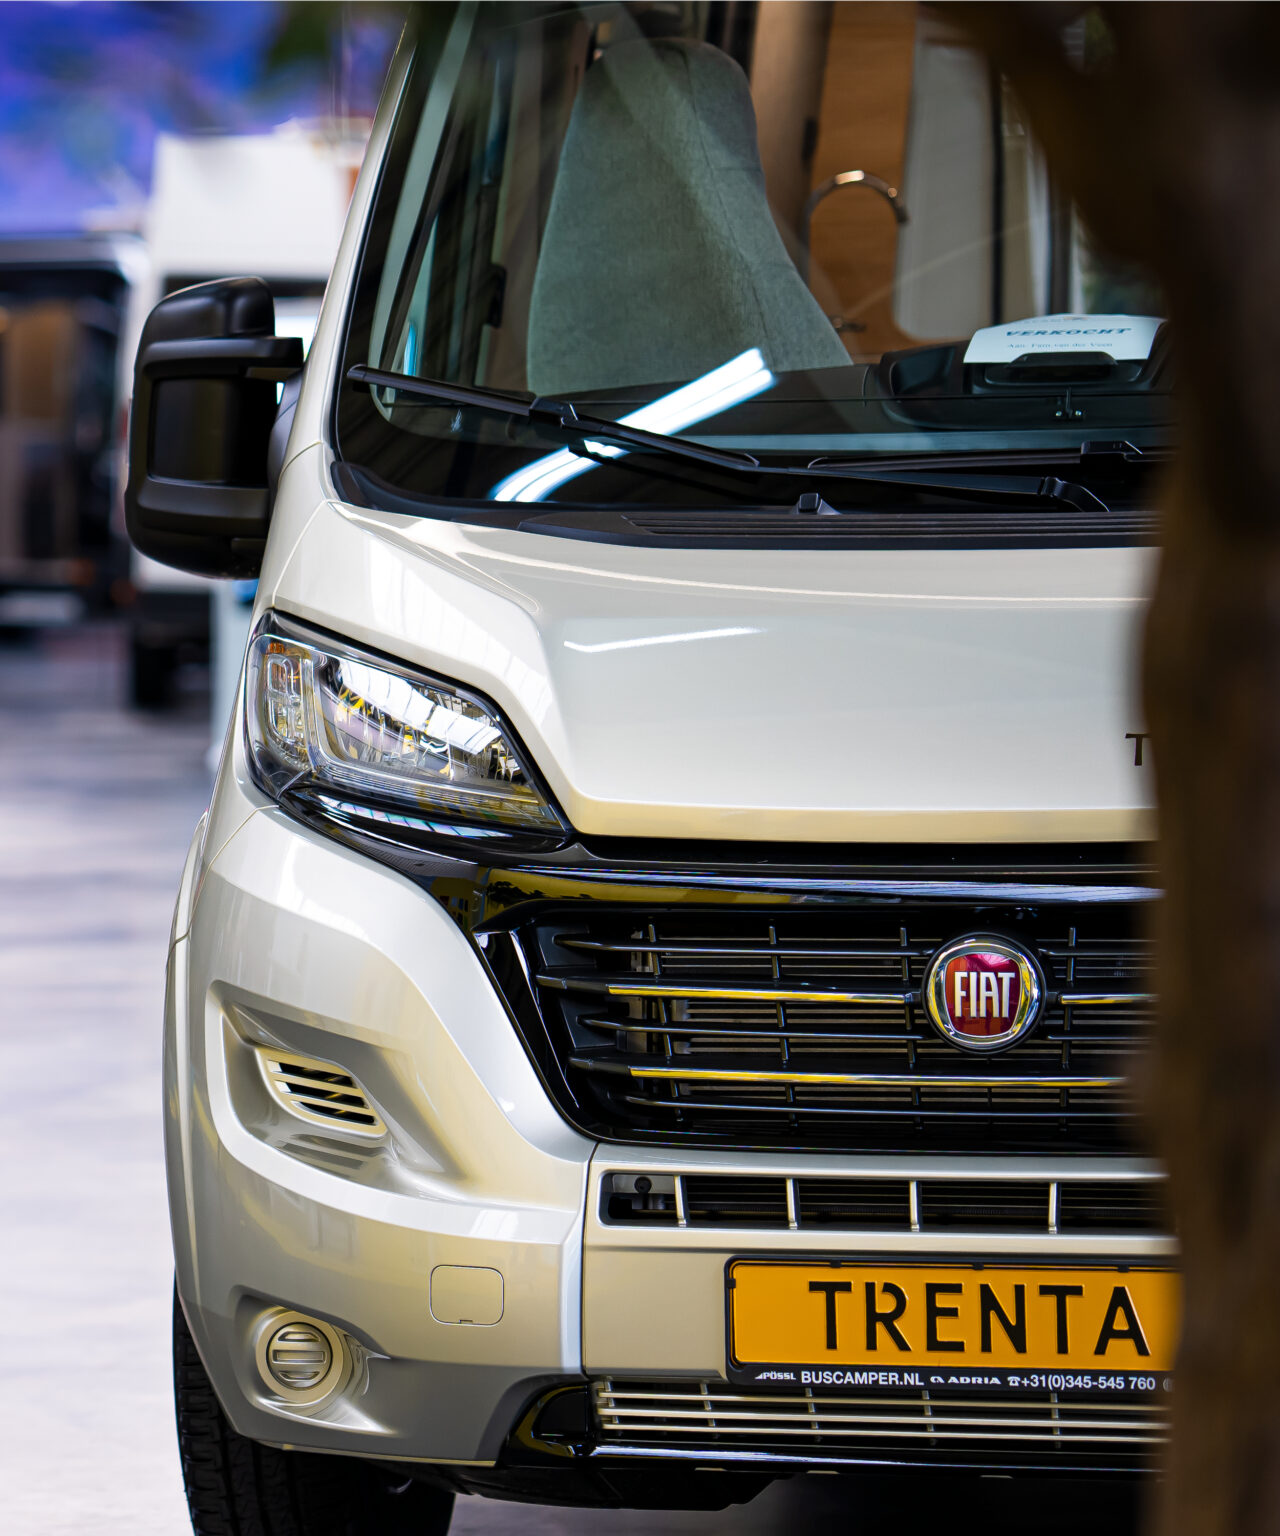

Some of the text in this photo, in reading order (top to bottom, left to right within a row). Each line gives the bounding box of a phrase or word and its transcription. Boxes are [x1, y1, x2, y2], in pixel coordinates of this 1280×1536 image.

[1006, 327, 1132, 337] VERKOCHT
[954, 971, 1016, 1018] FIAT
[808, 1280, 1152, 1357] TRENTA
[762, 1370, 1157, 1391] PÖSSL BUSCAMPER.NL ADRIA +31(0)345-545 760
